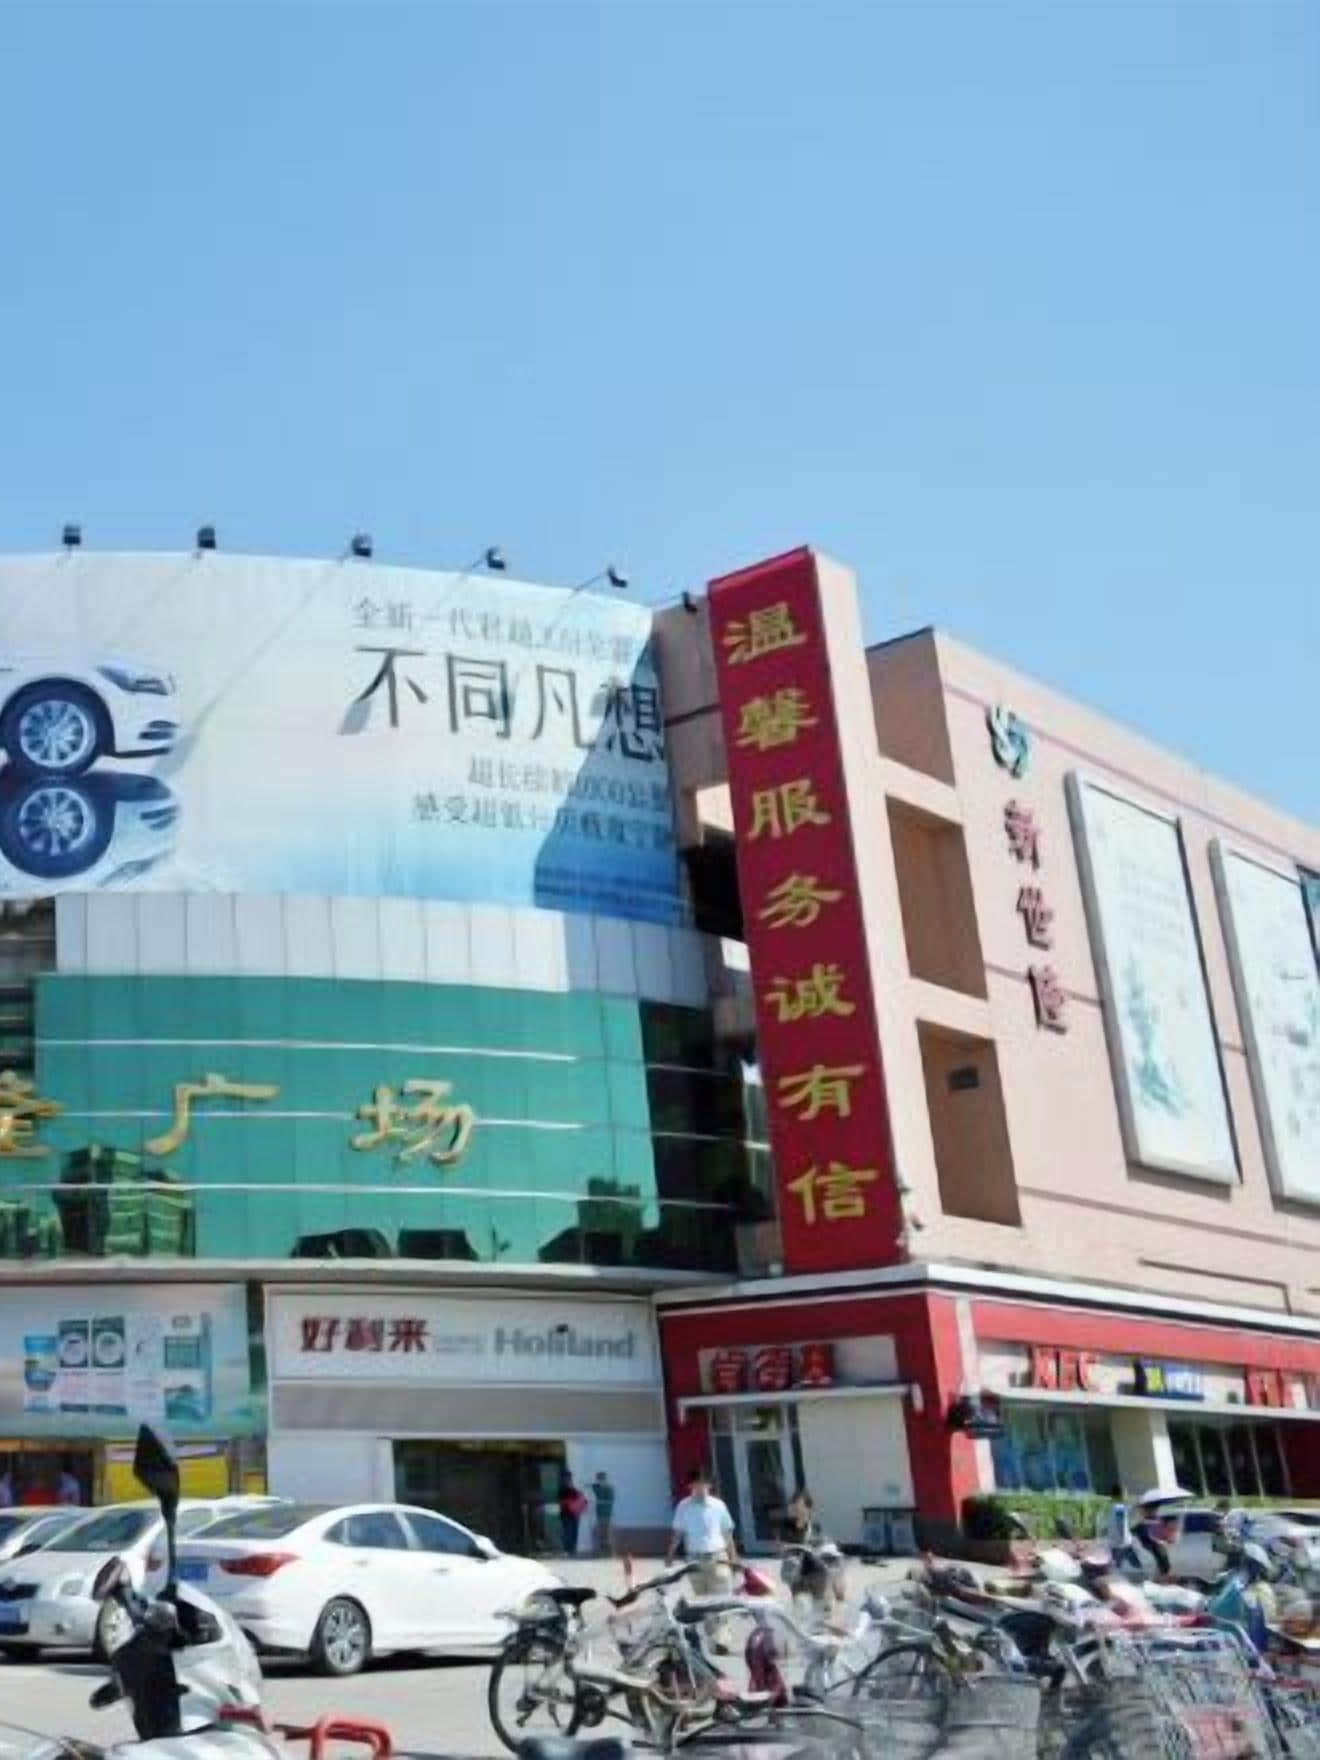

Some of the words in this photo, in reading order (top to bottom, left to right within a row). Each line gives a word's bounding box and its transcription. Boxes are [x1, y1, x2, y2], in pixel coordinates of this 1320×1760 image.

[354, 645, 665, 763] 不同凡想
[722, 602, 879, 1226] 温馨服务诚有信
[300, 1316, 430, 1353] 好利来
